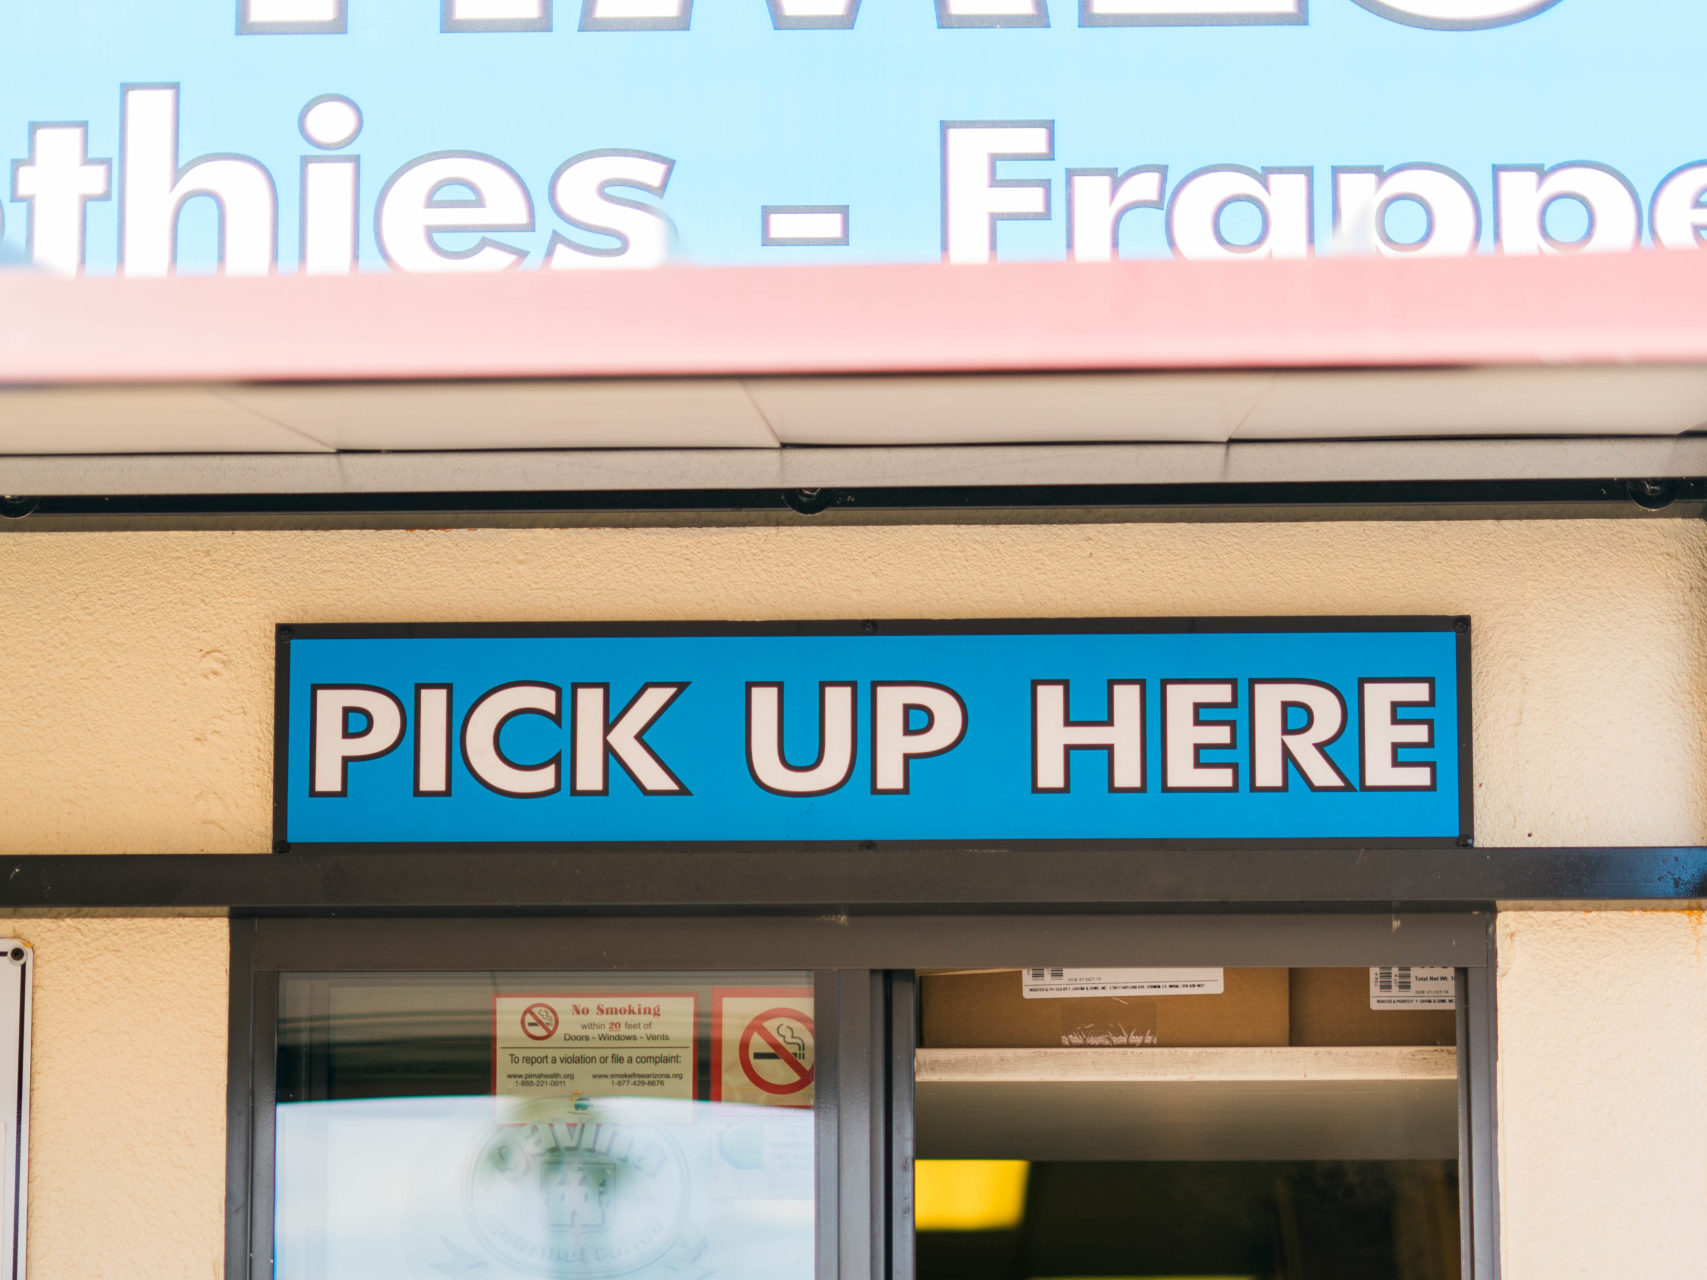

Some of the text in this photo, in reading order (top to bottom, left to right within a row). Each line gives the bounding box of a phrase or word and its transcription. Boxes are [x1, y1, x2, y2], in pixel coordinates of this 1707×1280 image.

[0, 82, 676, 276] thies
[308, 676, 1437, 799] PICK UP HERE
[571, 1003, 661, 1018] No Smoking
[580, 1021, 652, 1030] within 20 feet of
[563, 1033, 590, 1041] Doors
[598, 1033, 638, 1041] Windows
[645, 1033, 670, 1041] Vents
[508, 1053, 682, 1067] To report a violation or file a complaint:
